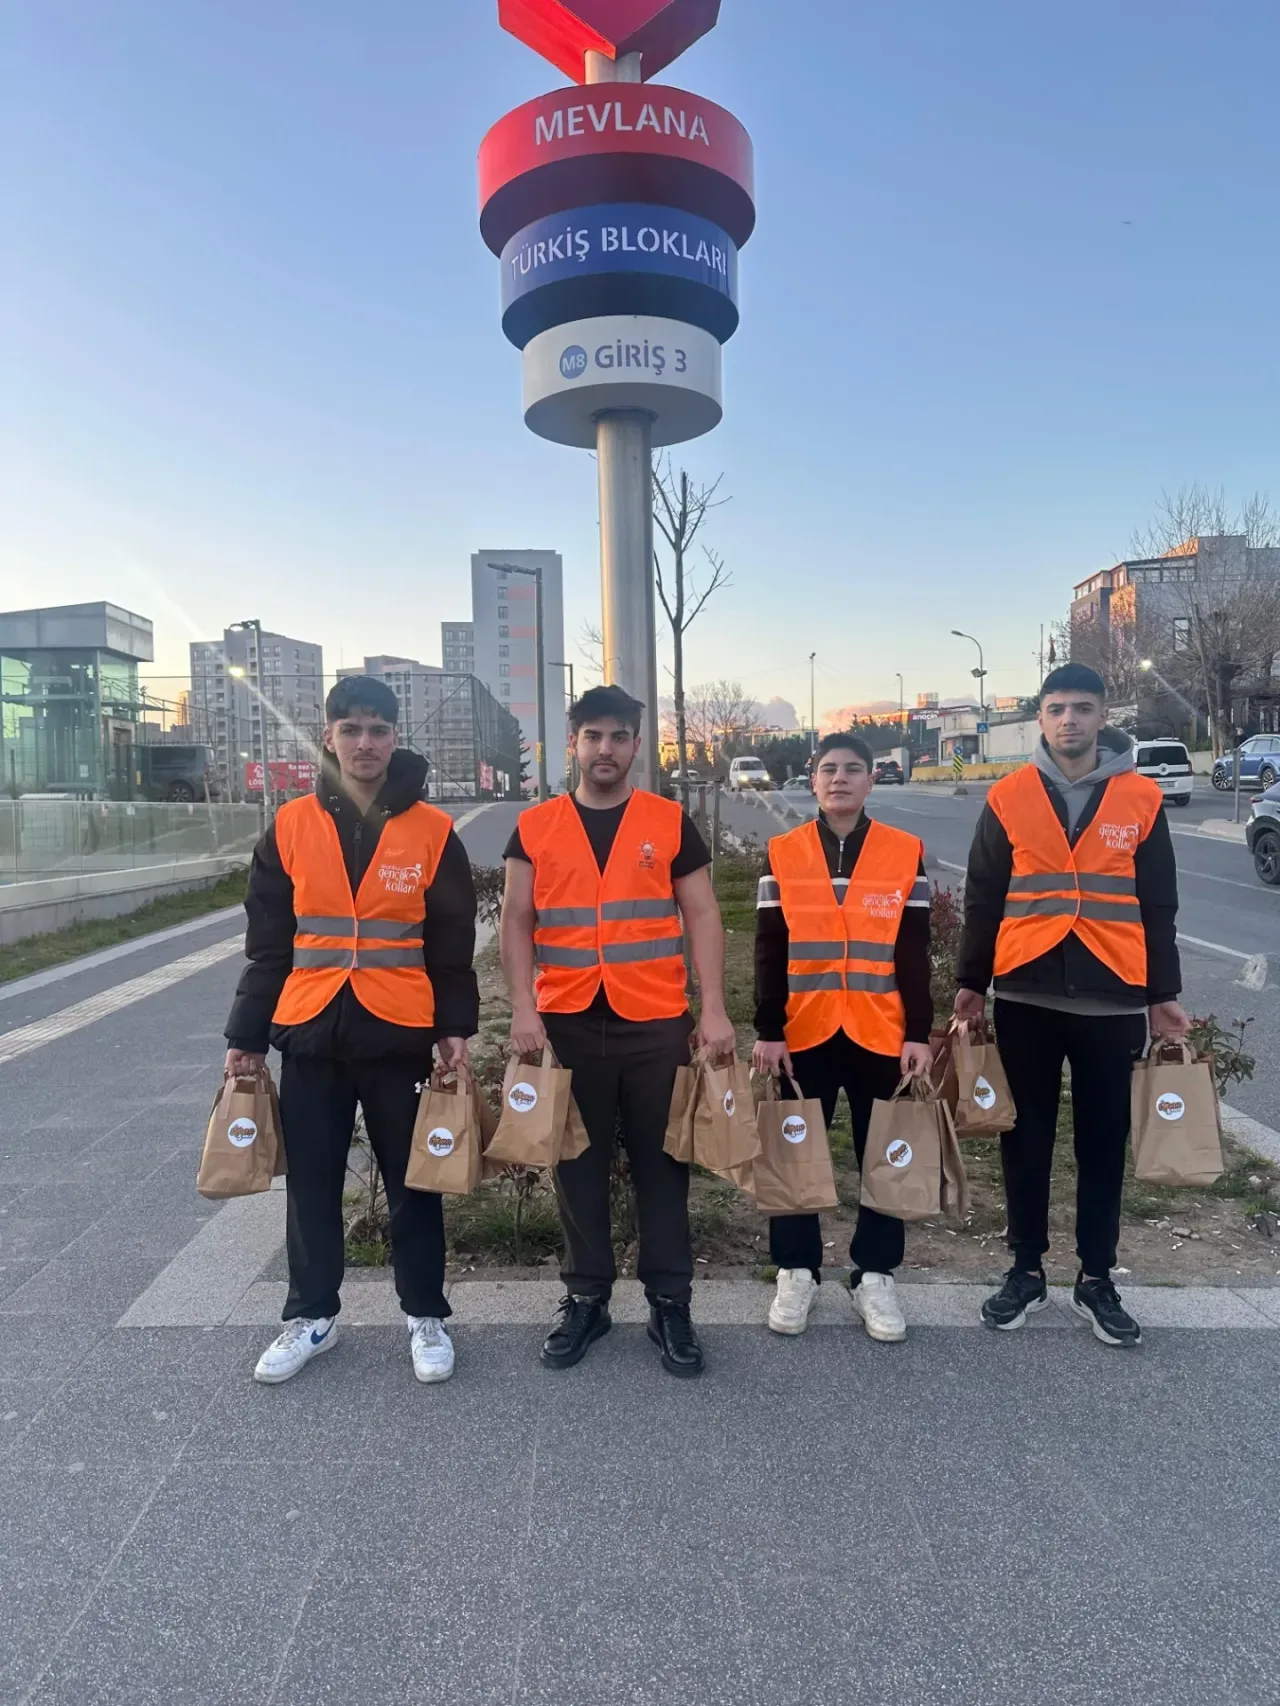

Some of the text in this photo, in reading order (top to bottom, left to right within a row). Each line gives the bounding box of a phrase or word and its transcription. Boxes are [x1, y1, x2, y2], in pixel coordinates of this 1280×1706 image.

[534, 102, 710, 146] MEVLANA
[510, 226, 727, 281] TÜRKİŞ BLOKLARI
[561, 339, 688, 375] M8 GİRİŞ 3
[378, 868, 409, 882] gençlik
[385, 879, 416, 894] kolları
